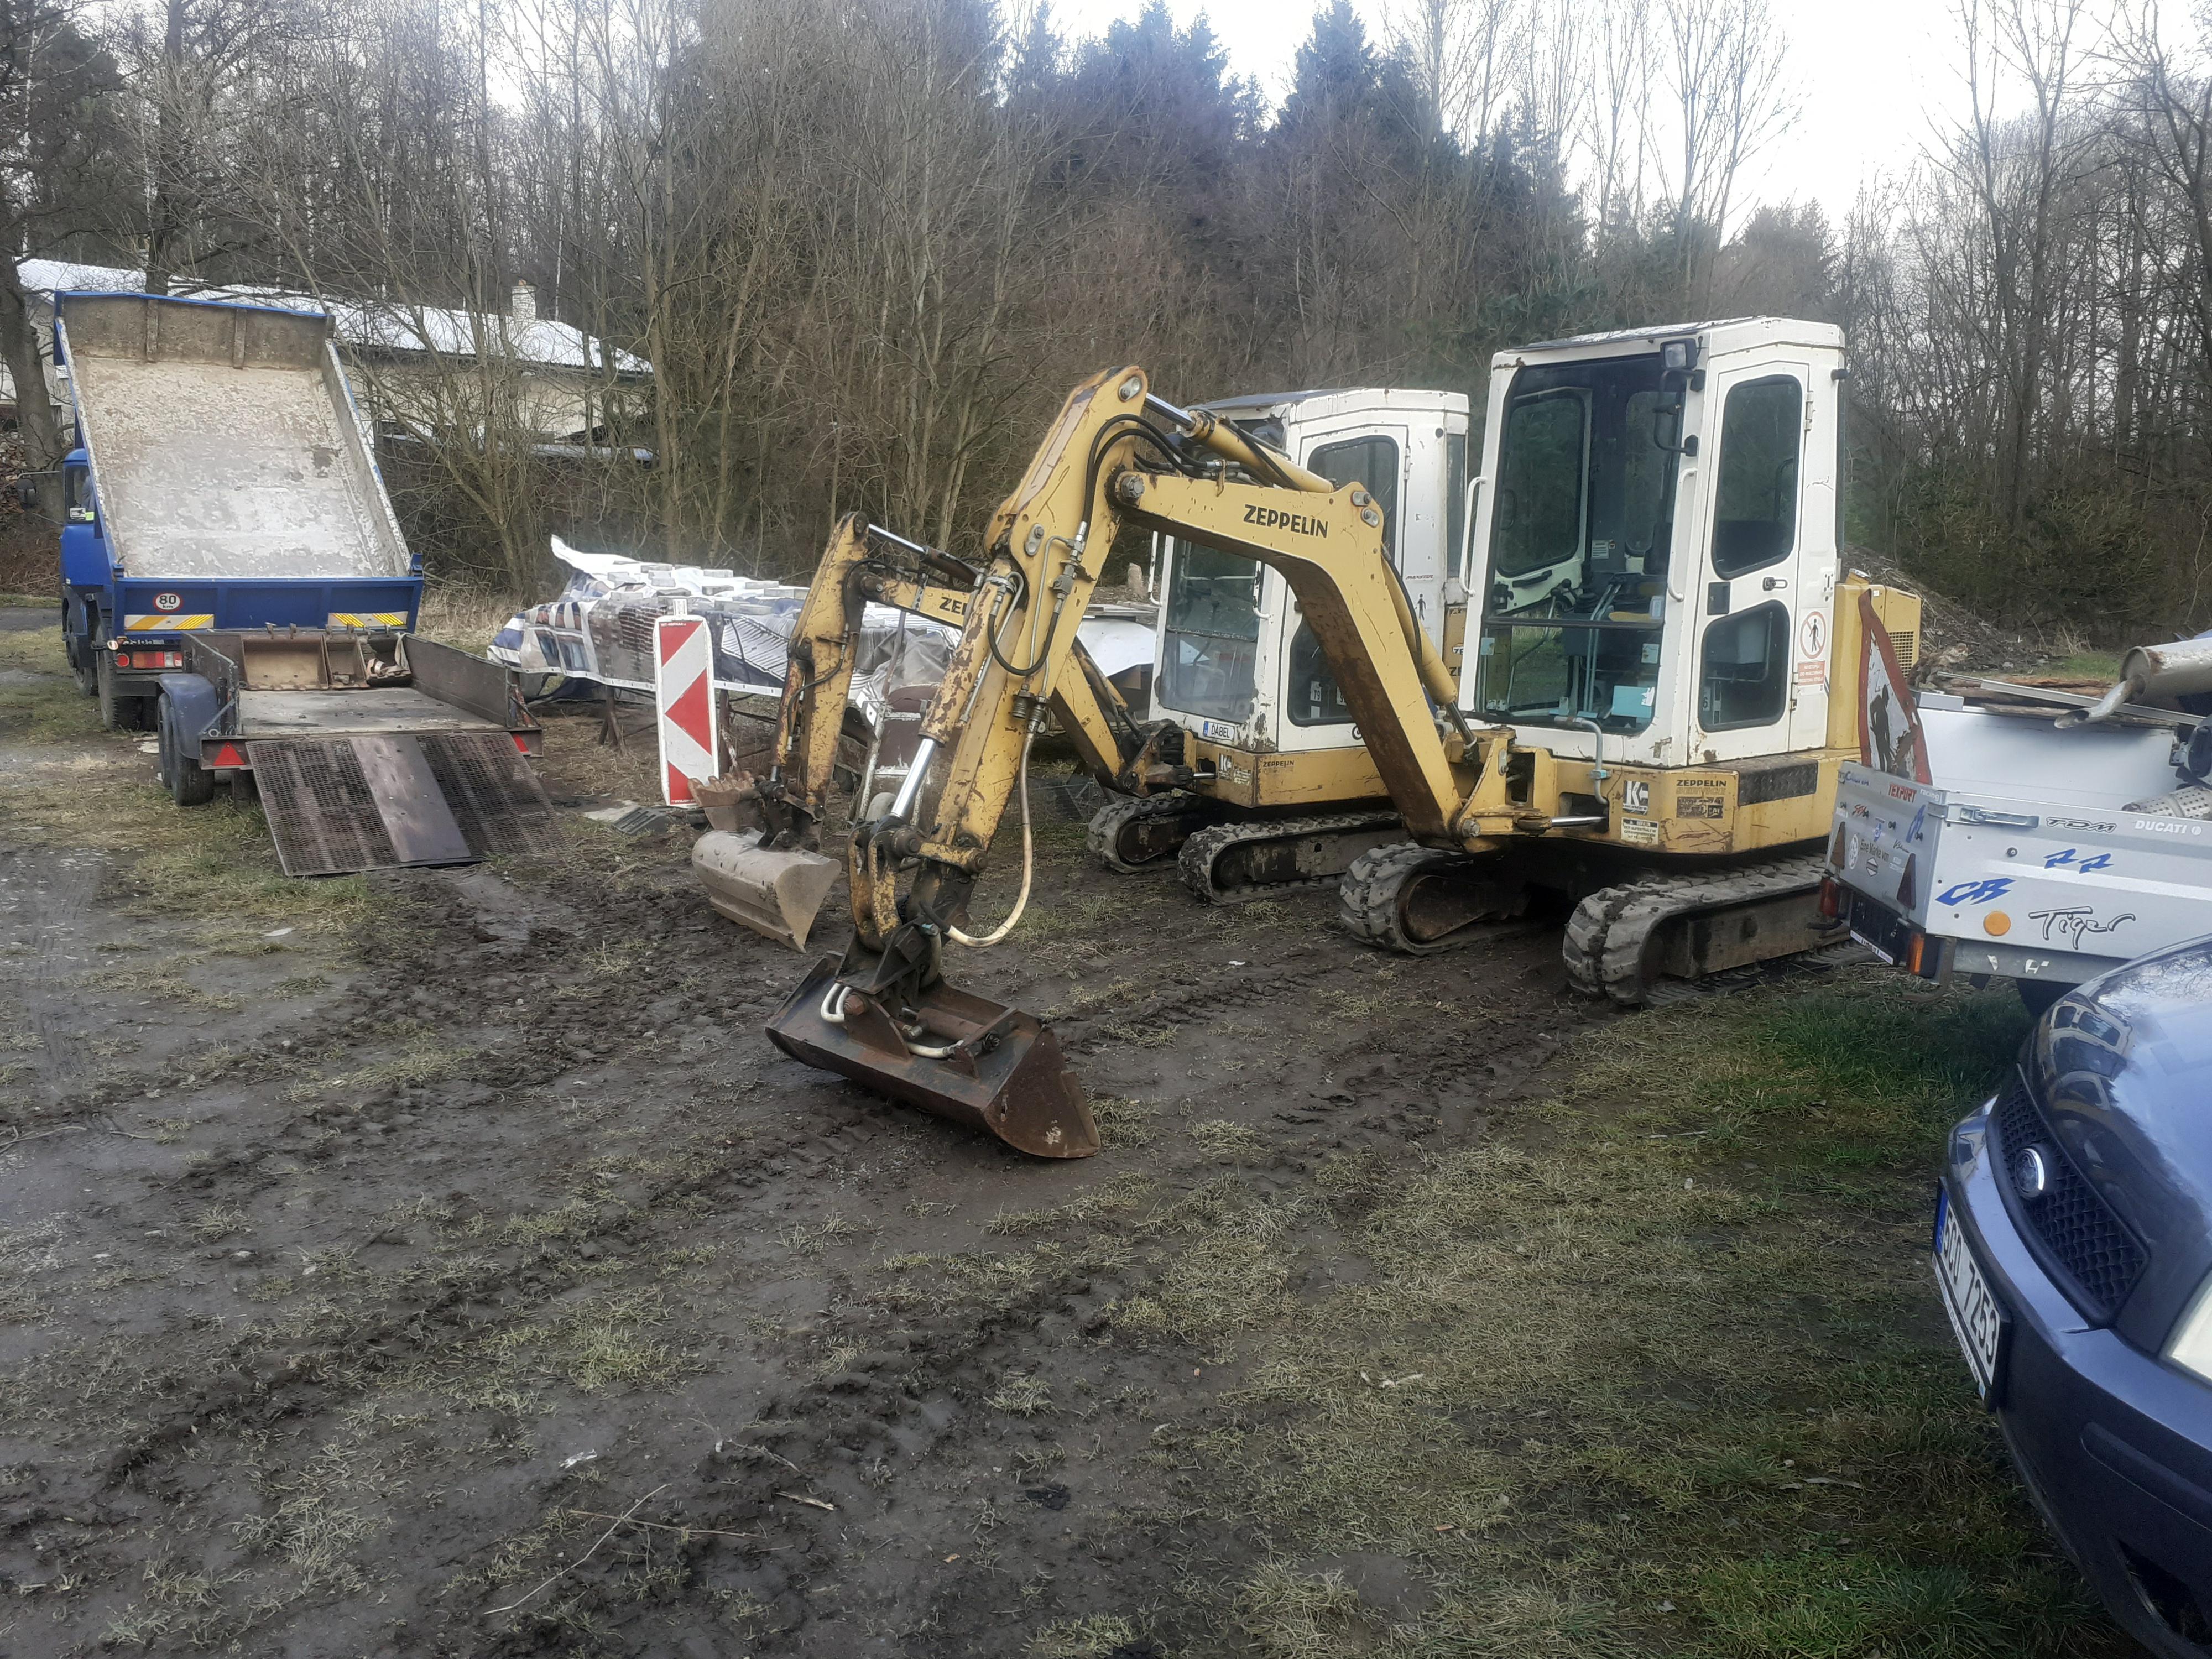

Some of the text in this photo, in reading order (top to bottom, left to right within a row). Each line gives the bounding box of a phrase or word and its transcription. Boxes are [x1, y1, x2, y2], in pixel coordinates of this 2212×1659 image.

[1243, 504, 1328, 538] ZEPPELIN
[159, 595, 176, 604] 80
[1888, 783, 1917, 802] TEXPORT
[1919, 788, 1940, 802] racing
[2135, 820, 2187, 834] DUCATI
[2028, 906, 2136, 950] Tiger
[1964, 1259, 1997, 1365] 7253
